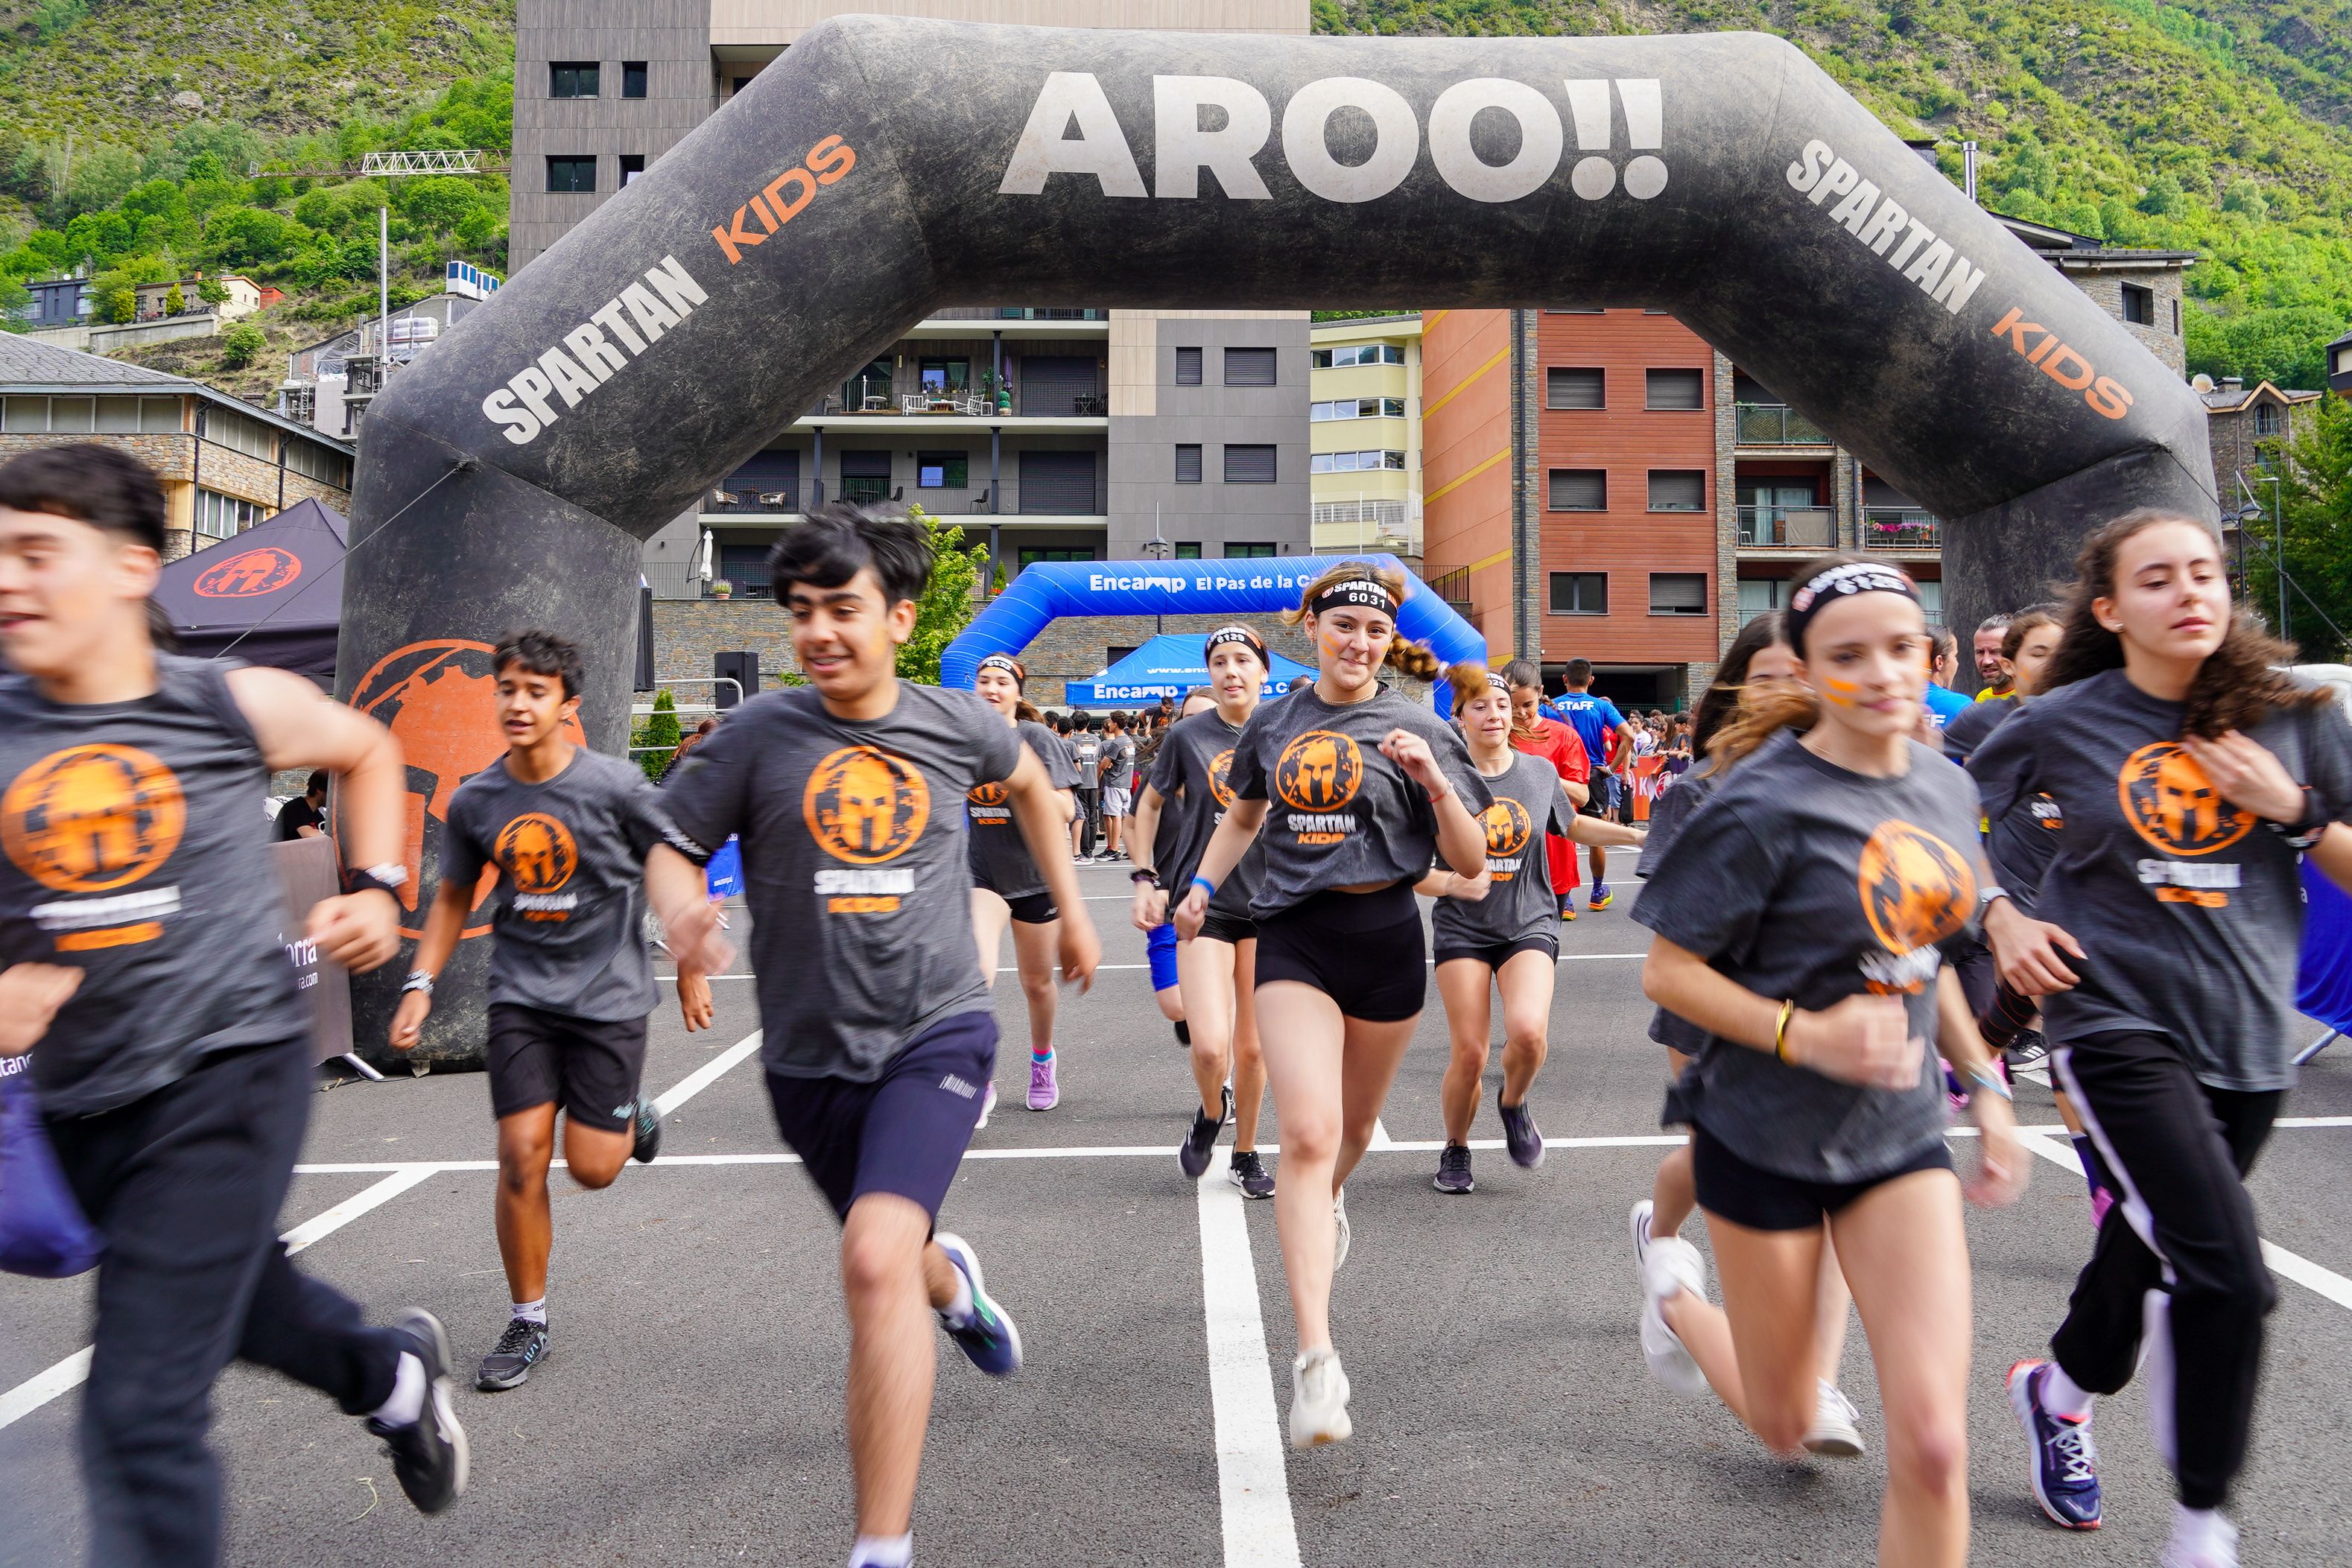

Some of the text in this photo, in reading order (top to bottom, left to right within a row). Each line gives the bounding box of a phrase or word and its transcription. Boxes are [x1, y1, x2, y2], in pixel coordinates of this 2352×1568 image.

[998, 71, 1669, 203] AROO!!
[1786, 139, 2134, 420] SPARTAN KIDS
[482, 134, 857, 445] SPARTAN KIDS
[1089, 574, 1187, 593] Encamp
[1196, 577, 1212, 591] El
[1216, 577, 1246, 591] Pas
[1250, 575, 1273, 589] de
[1277, 574, 1293, 588] la
[1334, 581, 1388, 598] SPARTAN
[1348, 592, 1386, 609] 6031
[1094, 683, 1179, 699] Encamp
[1557, 700, 1594, 711] STAFF
[1287, 813, 1357, 833] SPARTAN
[1297, 832, 1346, 845] KIDS
